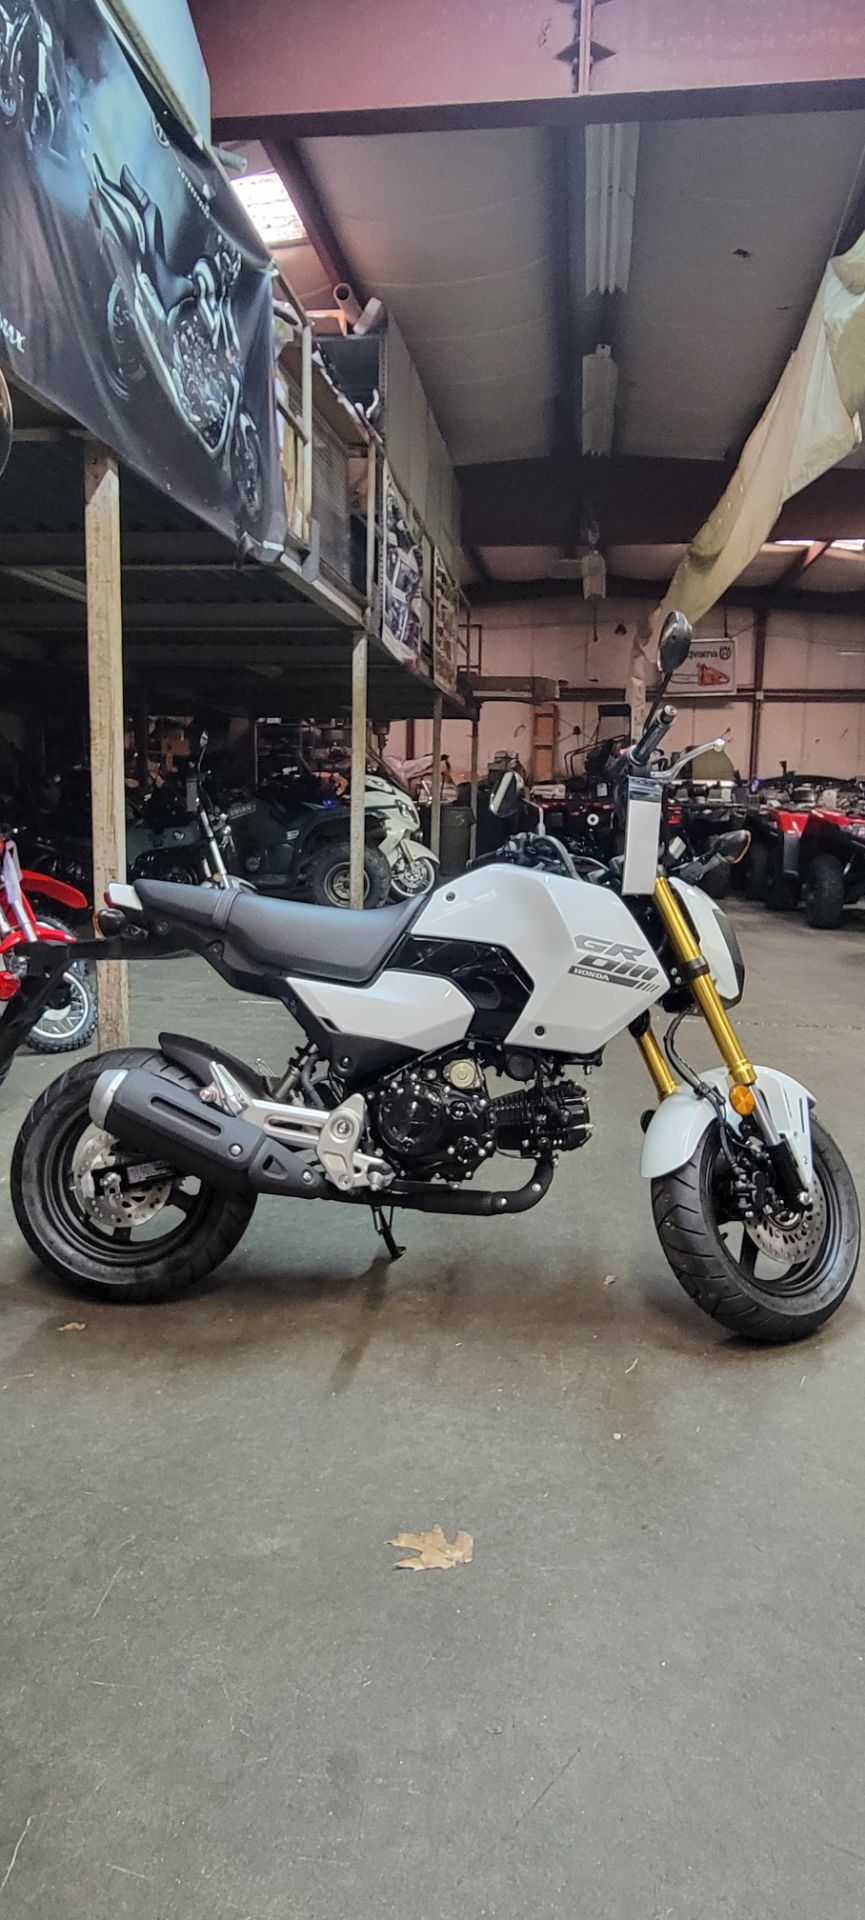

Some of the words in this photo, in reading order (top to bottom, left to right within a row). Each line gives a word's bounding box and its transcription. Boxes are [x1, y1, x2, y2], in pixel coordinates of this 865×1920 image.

[688, 650, 718, 660] qvarna
[574, 934, 647, 961] GR
[573, 968, 610, 982] HONDA
